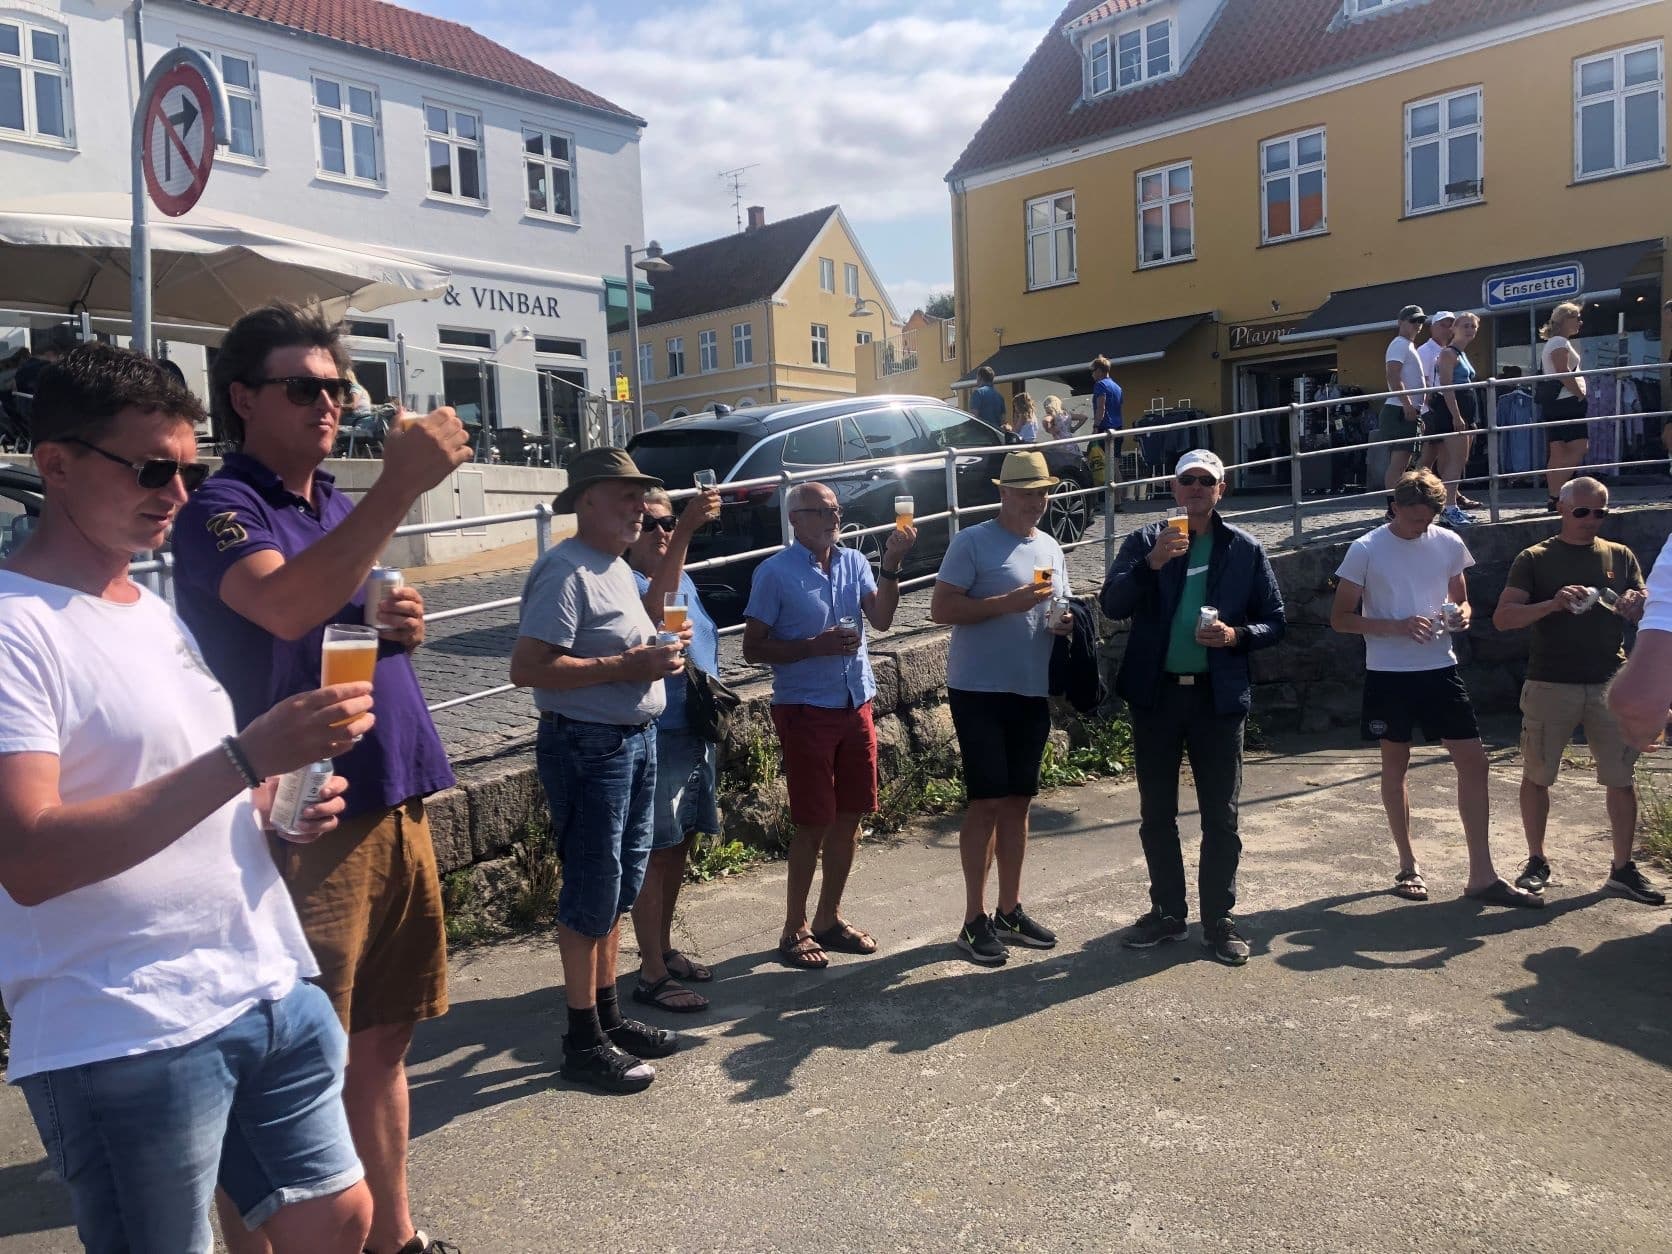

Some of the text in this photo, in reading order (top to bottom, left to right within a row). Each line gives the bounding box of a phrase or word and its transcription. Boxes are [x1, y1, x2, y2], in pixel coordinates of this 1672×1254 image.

[1503, 275, 1572, 296] Ensrettet
[444, 284, 561, 318] & VINBAR
[1231, 326, 1296, 347] Playm
